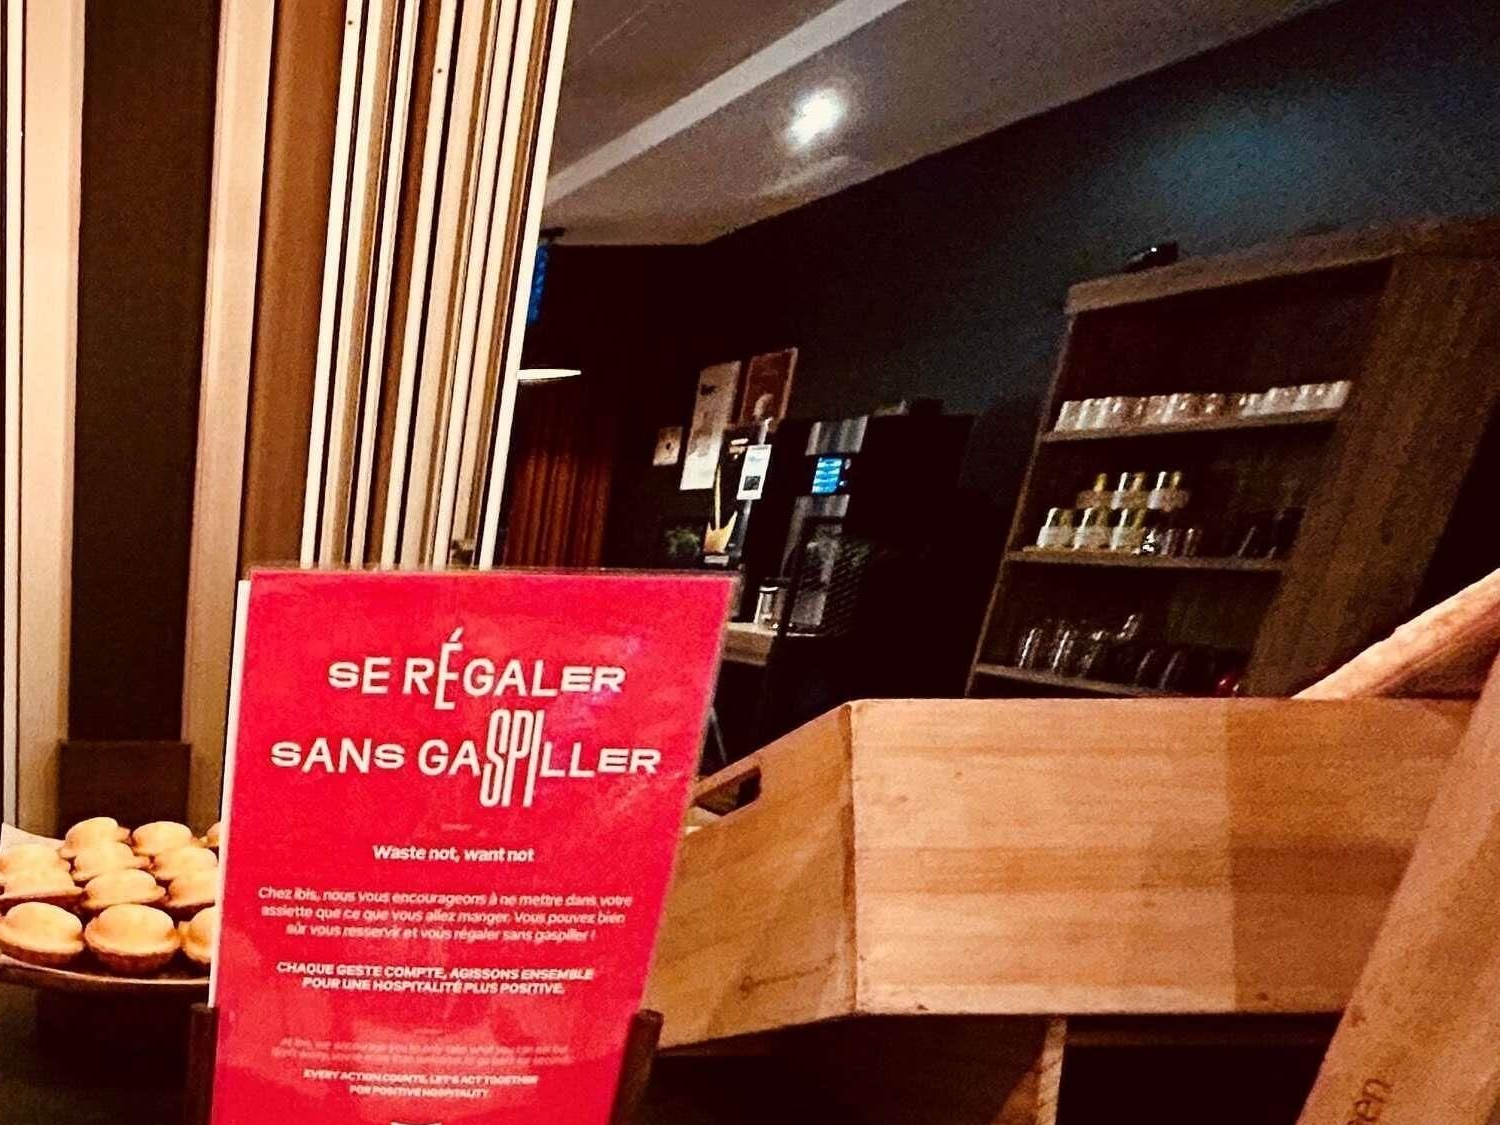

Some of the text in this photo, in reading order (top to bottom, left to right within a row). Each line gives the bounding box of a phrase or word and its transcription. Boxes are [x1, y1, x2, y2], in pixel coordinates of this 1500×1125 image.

[328, 626, 627, 710] SE RÉGALER
[271, 708, 662, 808] SANS GASPILLER
[372, 845, 534, 863] Waste not, want not
[258, 887, 292, 899] Chez
[323, 891, 355, 901] nous
[358, 892, 389, 903] vous
[392, 892, 486, 907] encourageons
[500, 894, 517, 905] ne
[519, 893, 563, 906] mettre
[565, 893, 597, 906] dans
[600, 894, 633, 907] votre
[261, 905, 313, 918] assiette
[315, 908, 340, 921] que
[343, 909, 360, 919] ce
[363, 909, 388, 921] que
[392, 910, 422, 921] vous
[425, 910, 455, 922] allez
[514, 911, 546, 924] Vous
[548, 913, 595, 926] pouvez
[598, 911, 626, 924] bien
[310, 925, 340, 936] vous
[342, 925, 400, 938] resservir
[403, 927, 418, 938] et
[421, 928, 452, 939] vous
[454, 928, 500, 943] régaler
[503, 930, 532, 941] sans
[276, 962, 595, 980] CHAQUE GESTE COMPTE, AGISSONS ENSEMBLE
[302, 977, 341, 989] POUR
[343, 978, 370, 989] UNE
[373, 979, 462, 993] HOSPITALITÉ
[464, 981, 498, 994] PLUS
